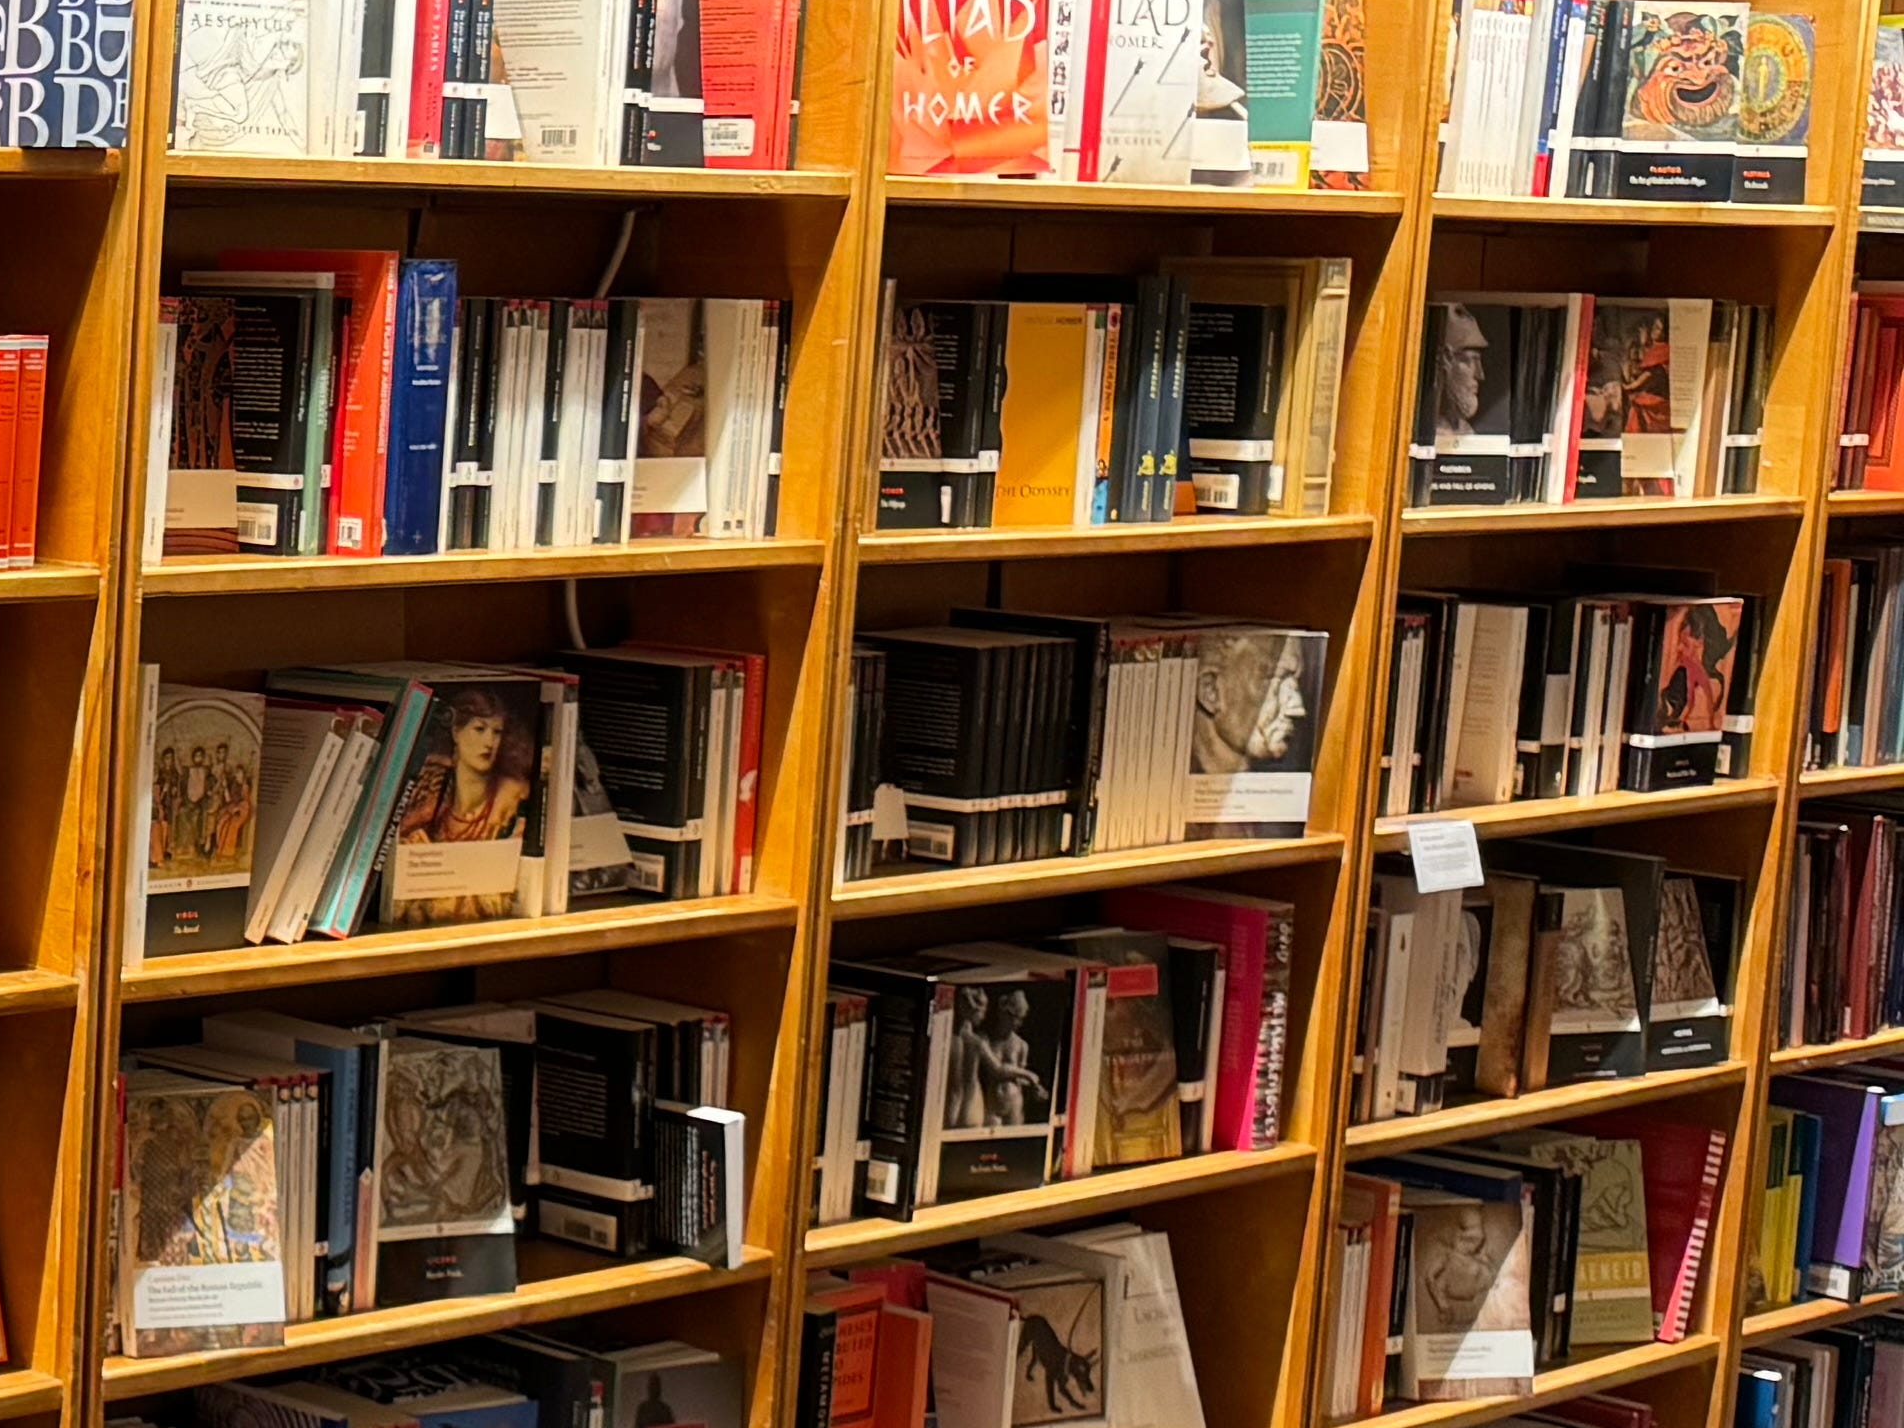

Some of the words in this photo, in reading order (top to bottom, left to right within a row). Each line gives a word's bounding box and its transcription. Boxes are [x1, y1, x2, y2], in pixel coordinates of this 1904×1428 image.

[191, 13, 296, 35] AESCHYLUS
[946, 55, 975, 79] OF
[902, 91, 1035, 127] HOMER
